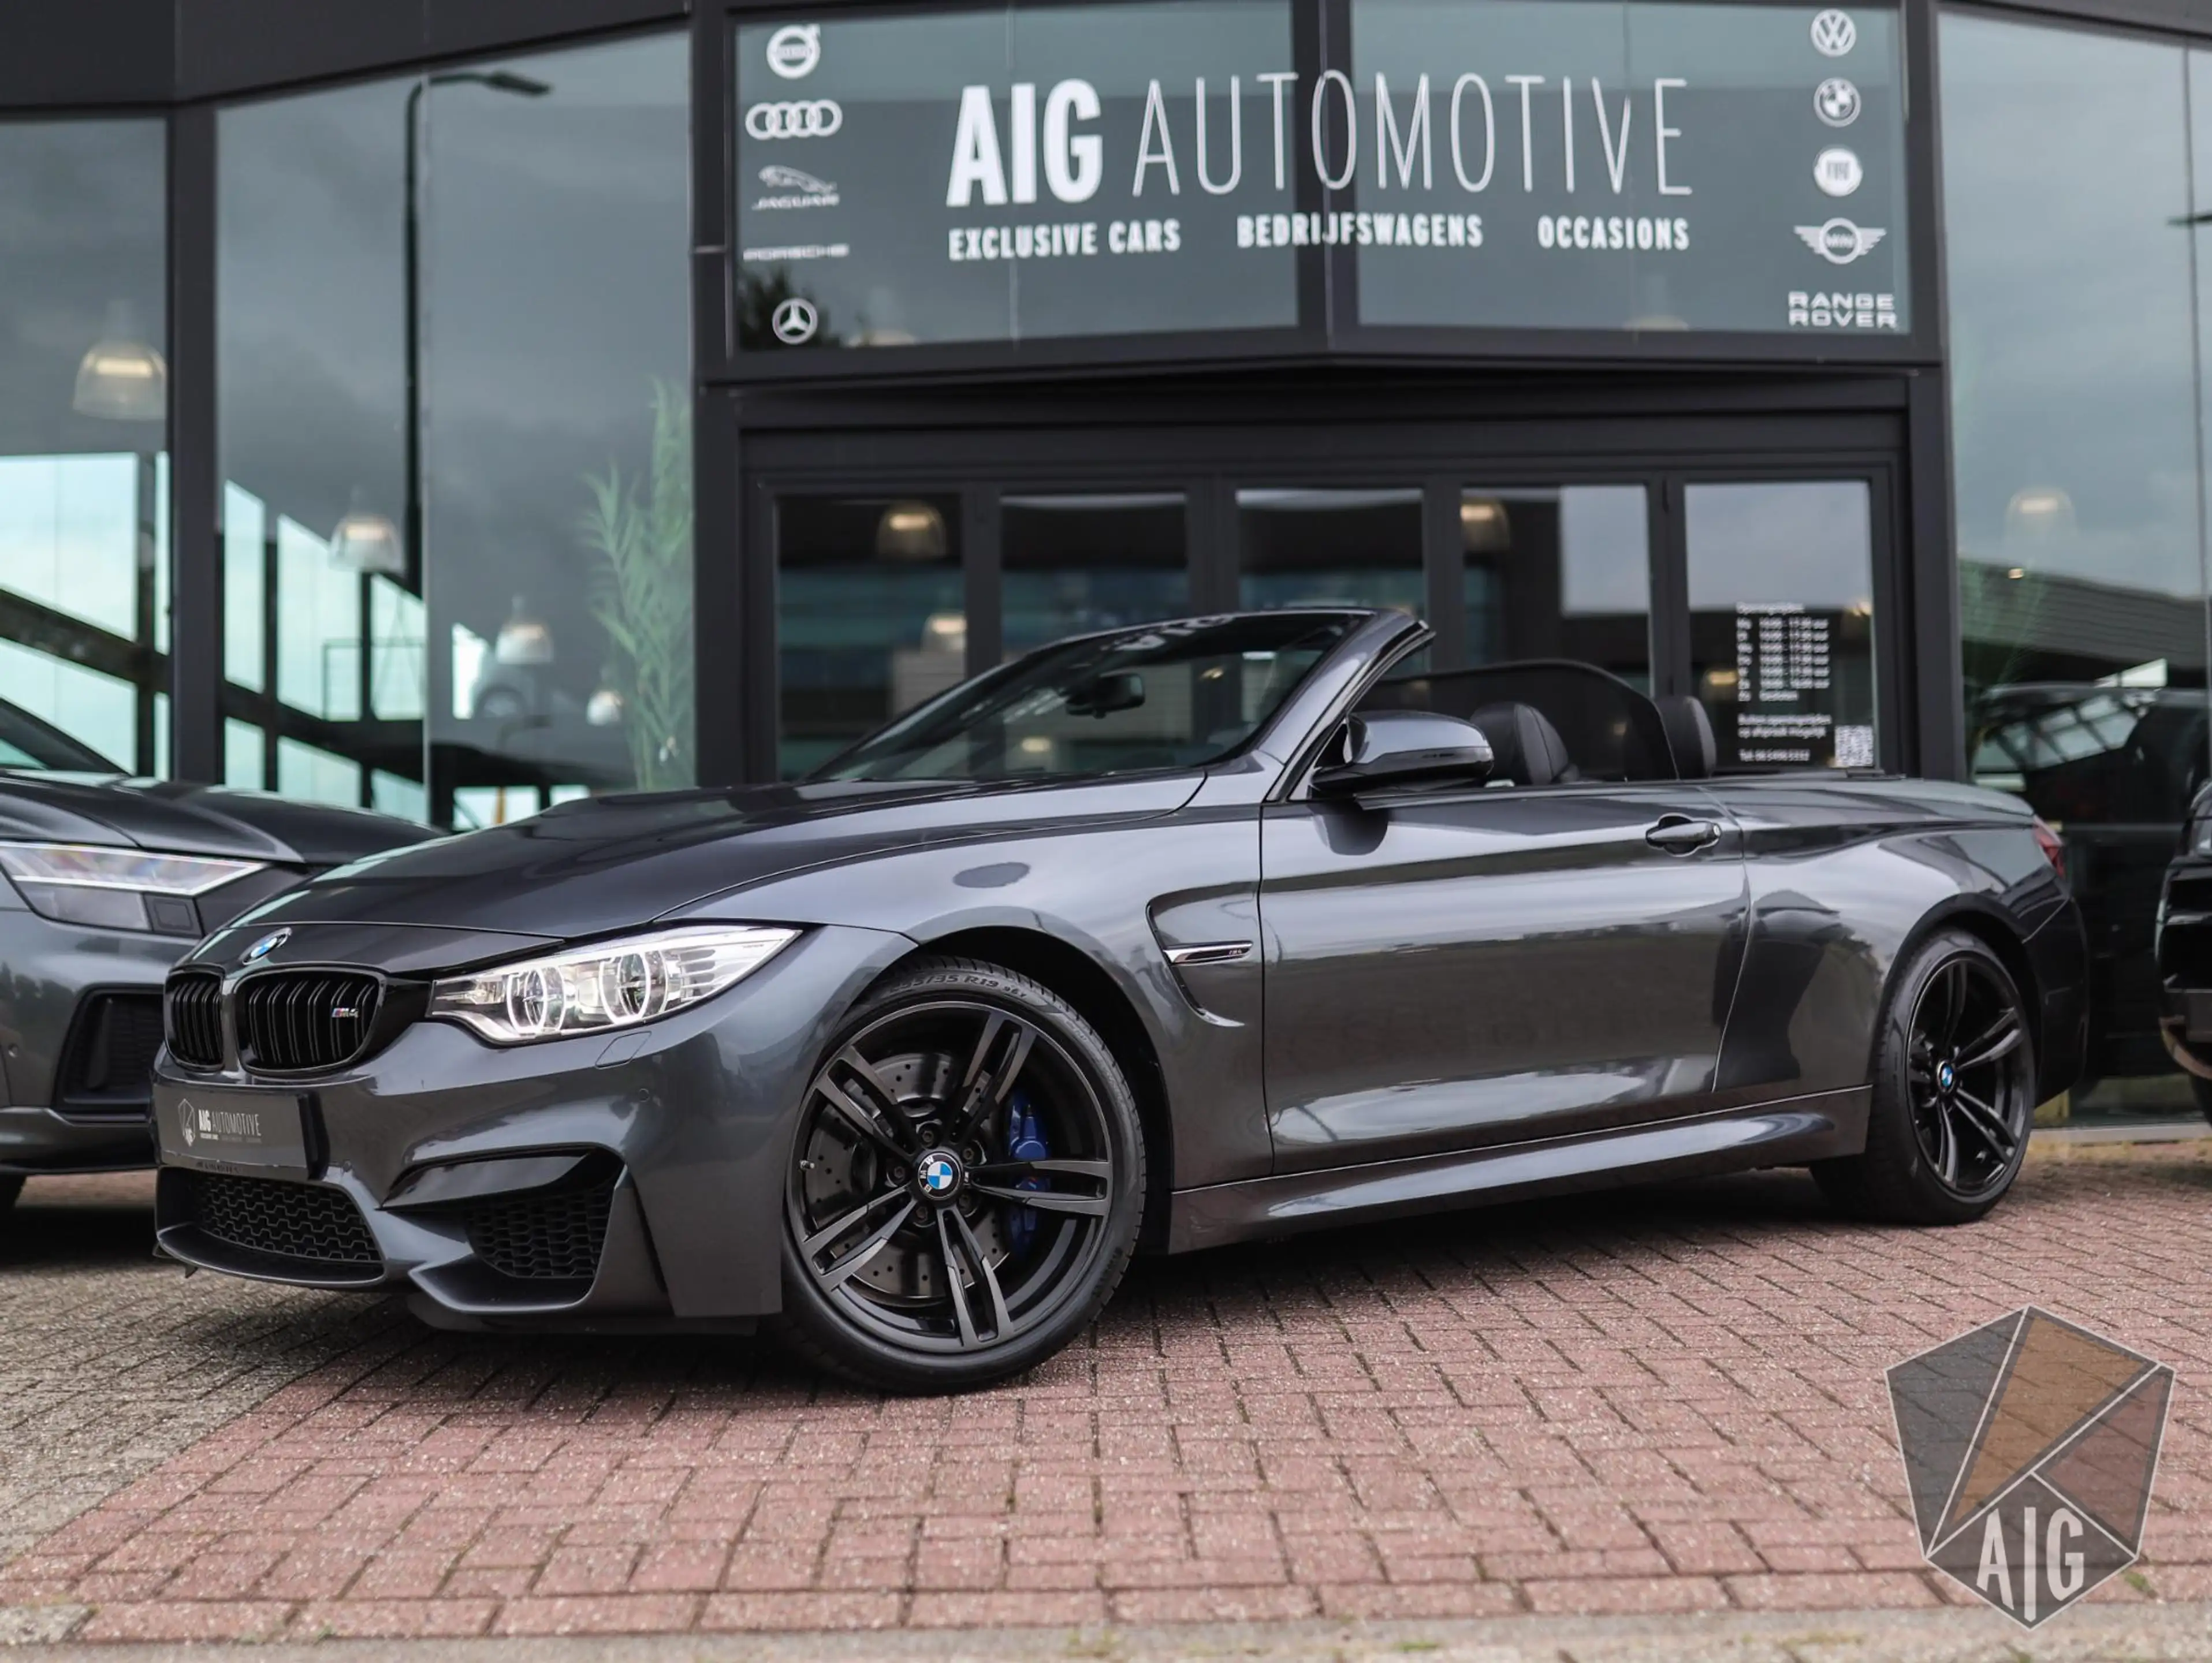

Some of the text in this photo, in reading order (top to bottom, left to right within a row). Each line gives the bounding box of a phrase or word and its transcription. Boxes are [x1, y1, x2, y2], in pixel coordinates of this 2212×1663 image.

[946, 69, 1693, 207] AIG AUTOMOTIVE
[751, 193, 839, 211] JAGUAR
[948, 212, 1690, 261] EXCLUSIVE CARS BEDRIJFSWAGENS OCCASIONS
[1788, 290, 1895, 311] RANGE
[1788, 308, 1897, 329] ROVER
[211, 1110, 262, 1136] AUTOMOTIVE
